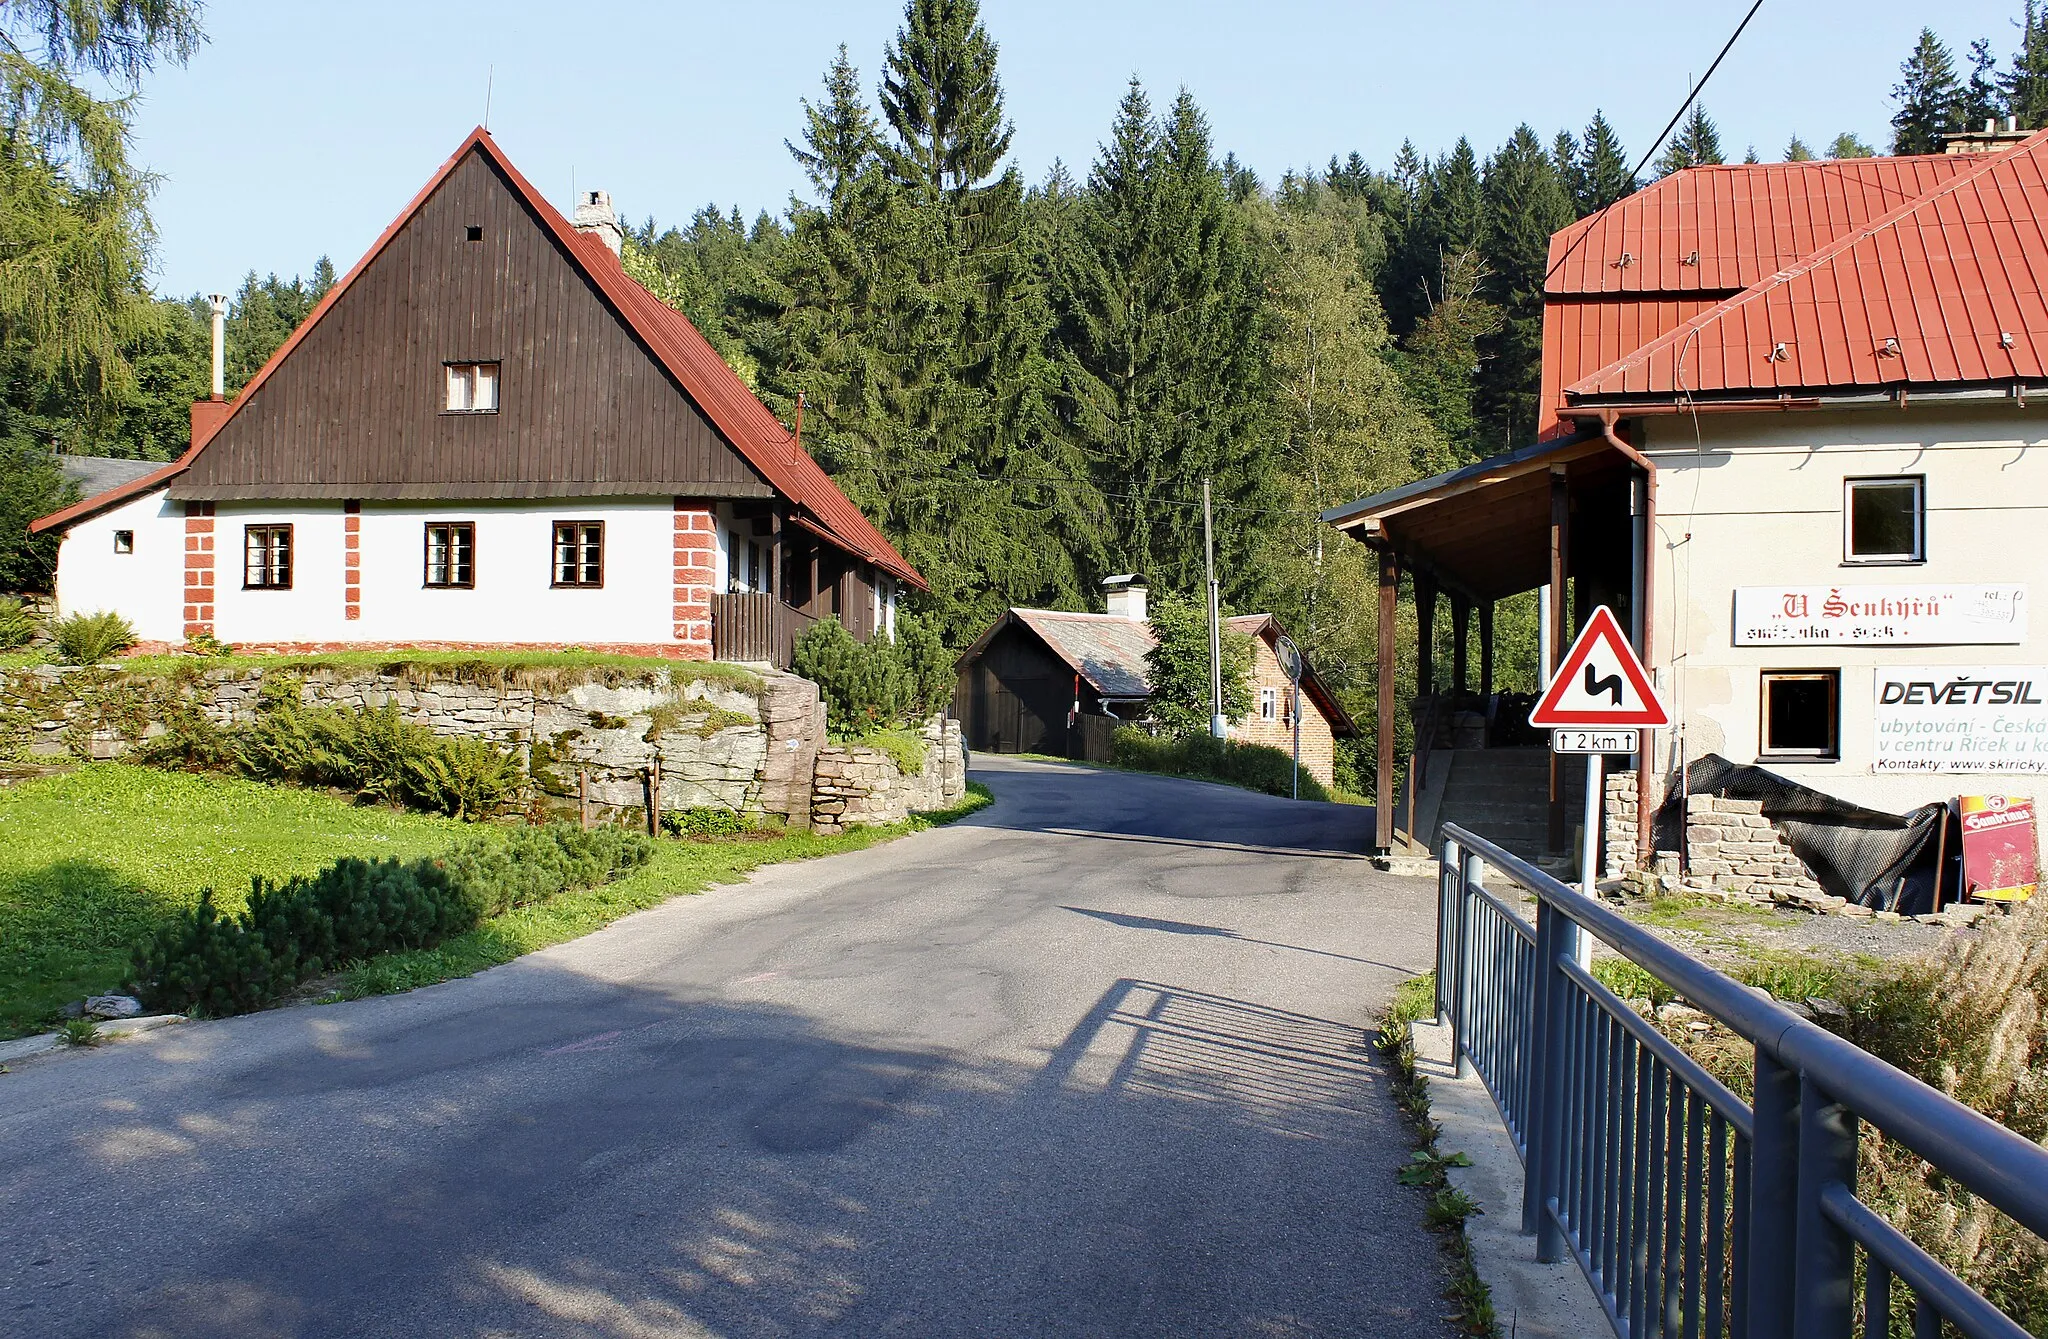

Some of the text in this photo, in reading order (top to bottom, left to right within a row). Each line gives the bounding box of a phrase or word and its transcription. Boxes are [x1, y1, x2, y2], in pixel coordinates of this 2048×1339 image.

[1879, 676, 2042, 704] DEVĚTSIL
[1880, 718, 1976, 736] ubytování
[1993, 715, 2047, 733] Česká
[1577, 733, 1617, 749] 2 km
[1880, 740, 1888, 751] v
[1895, 738, 1953, 751] centru
[1960, 733, 2008, 751] Říček
[2015, 740, 2026, 751] u
[1878, 759, 1946, 772] Kontakty:
[1965, 809, 2030, 829] Gambrinus
